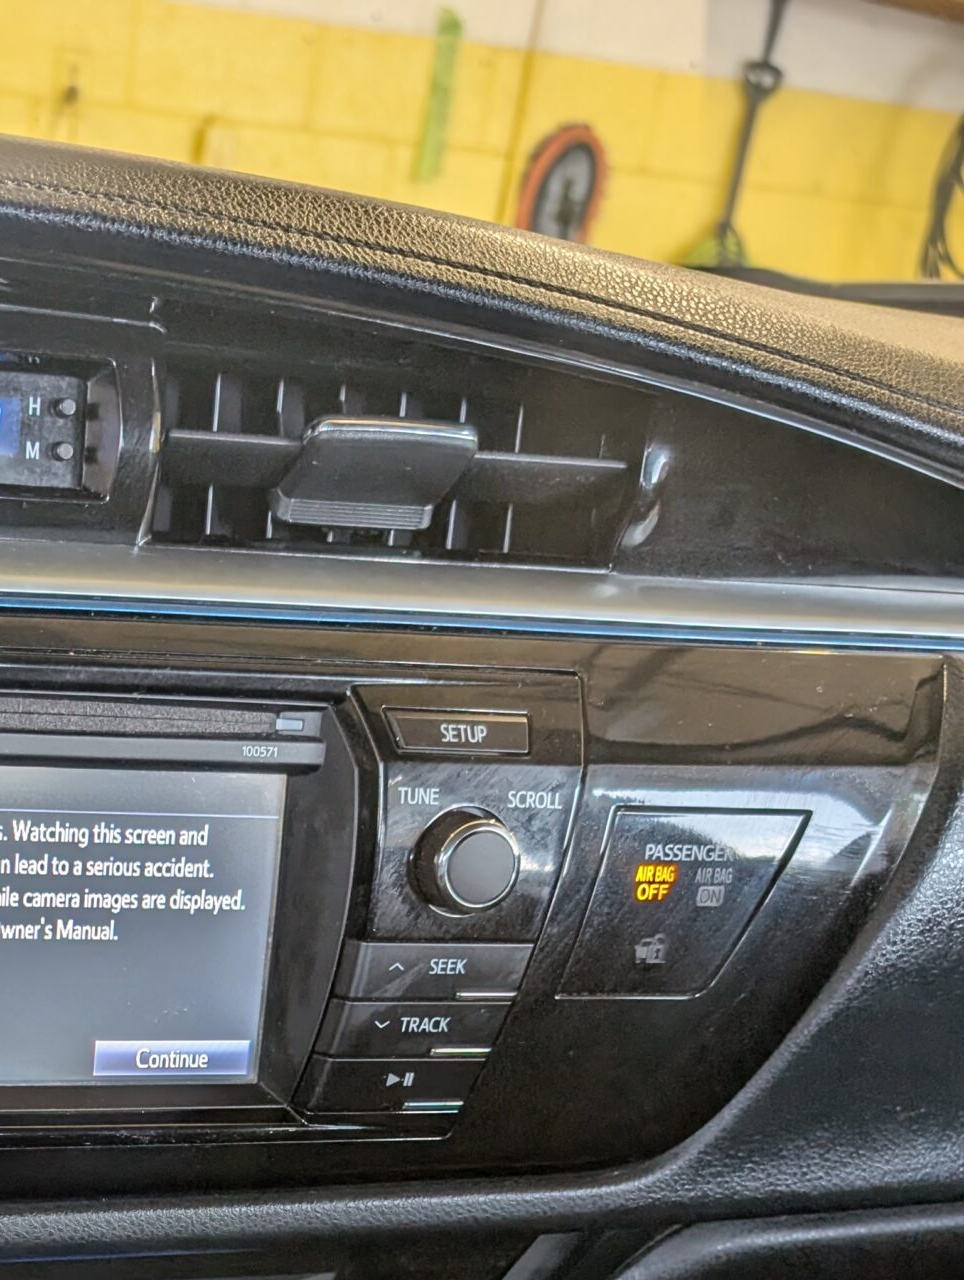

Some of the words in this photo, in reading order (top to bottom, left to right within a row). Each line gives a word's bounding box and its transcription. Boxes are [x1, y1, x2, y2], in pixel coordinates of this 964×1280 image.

[28, 398, 41, 416] H
[26, 442, 40, 460] M
[440, 723, 487, 743] SETUP
[241, 745, 279, 758] 100571
[398, 787, 440, 805] TUNE
[507, 790, 563, 809] SCROLL
[12, 819, 88, 848] Watching
[92, 821, 121, 844] this
[125, 827, 175, 846] screen
[179, 824, 209, 846] and
[645, 844, 734, 862] PASSENGER
[14, 853, 49, 876] lead
[51, 857, 69, 876] to
[73, 860, 82, 876] a
[86, 856, 141, 877] serious
[144, 857, 214, 878] accident.
[636, 865, 653, 882] AIR
[655, 865, 675, 882] BAG
[695, 867, 711, 883] AIR
[714, 867, 733, 884] BAG
[23, 893, 80, 909] camera
[84, 888, 137, 914] images
[142, 895, 166, 910] are
[169, 889, 245, 914] displayed.
[636, 883, 669, 901] OFF
[699, 888, 722, 904] ON
[56, 919, 118, 941] Manual.
[428, 958, 467, 975] SEEK
[400, 1017, 451, 1033] TRACK
[135, 1047, 208, 1070] Continue
